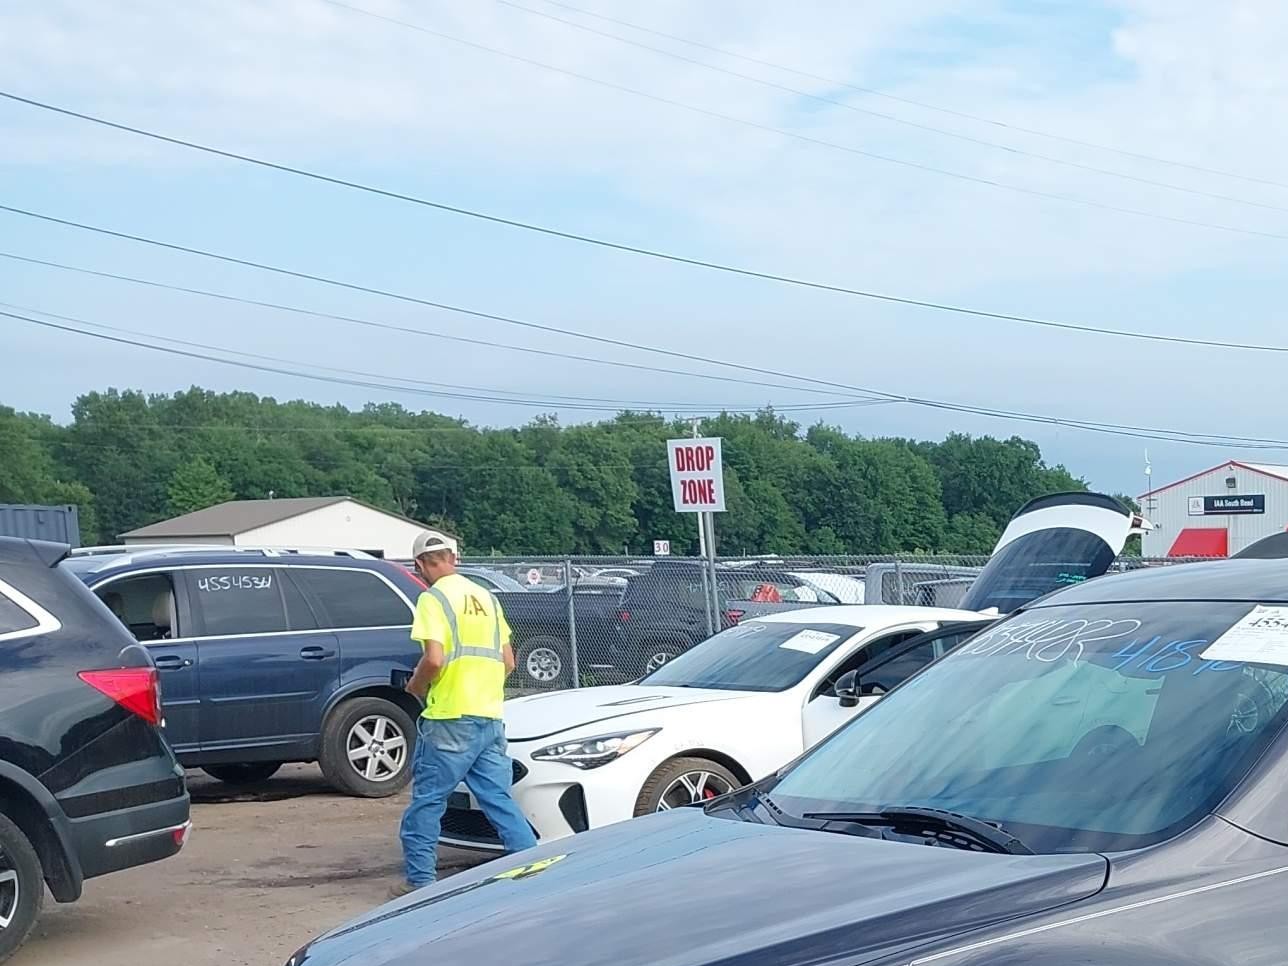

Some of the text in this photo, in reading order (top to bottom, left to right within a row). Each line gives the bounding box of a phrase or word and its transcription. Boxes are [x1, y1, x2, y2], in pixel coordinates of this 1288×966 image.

[674, 446, 715, 472] DROP
[680, 479, 716, 505] ZONE
[655, 542, 669, 554] 30
[463, 594, 488, 616] IA
